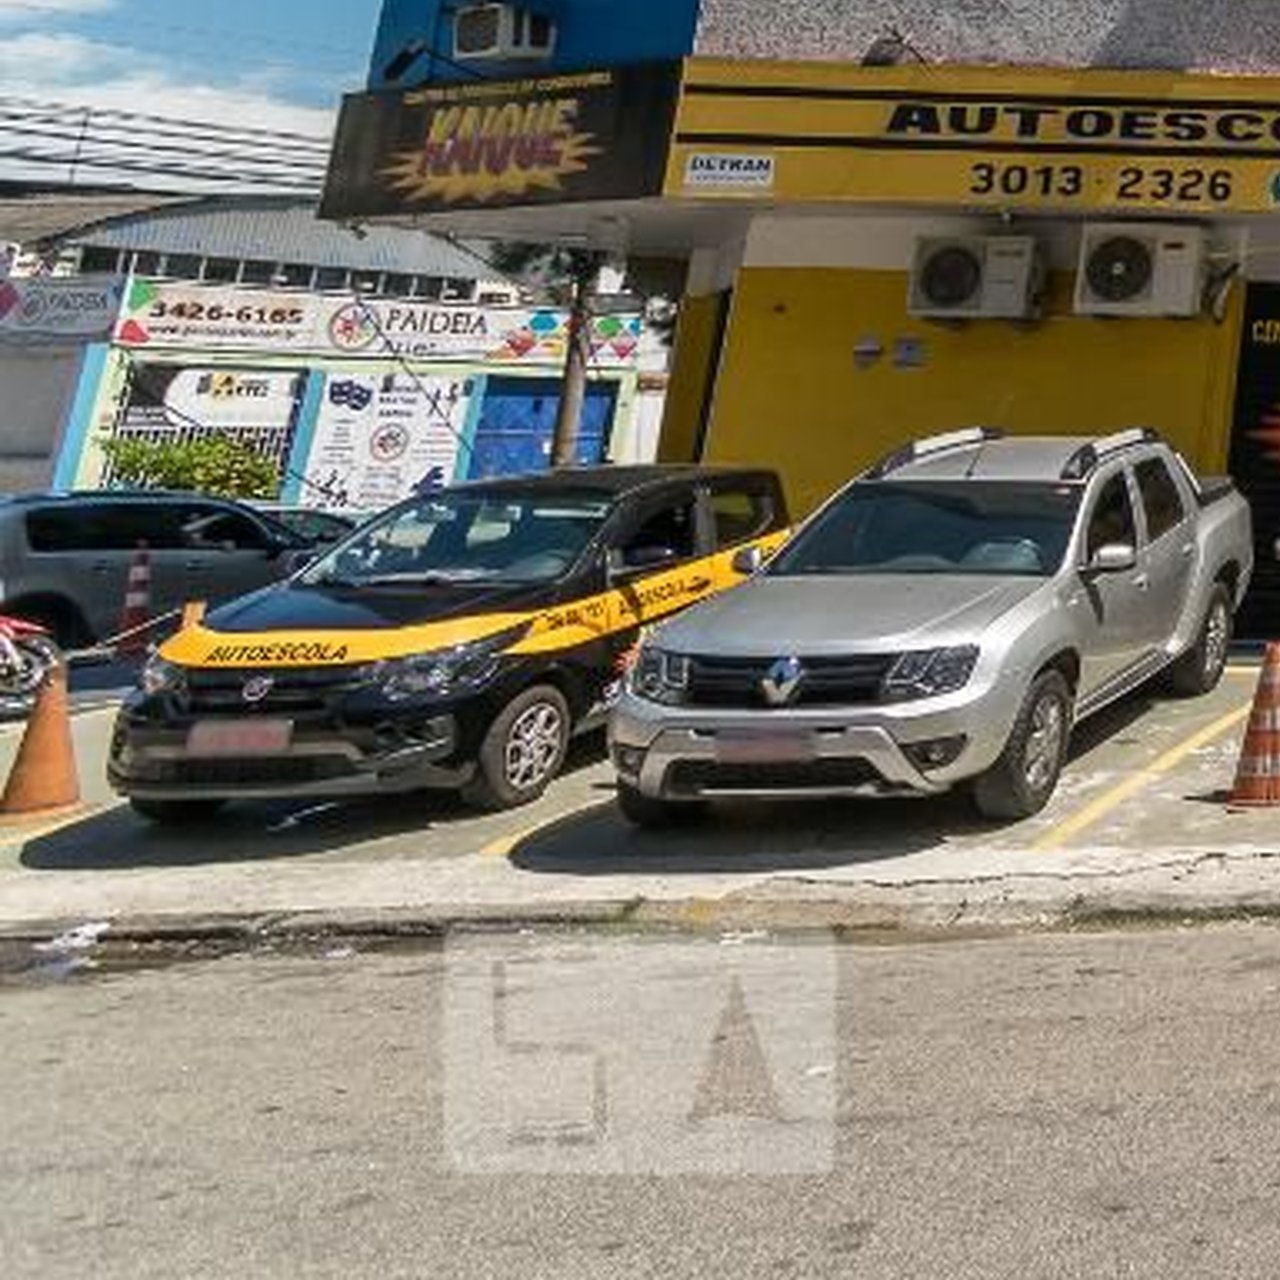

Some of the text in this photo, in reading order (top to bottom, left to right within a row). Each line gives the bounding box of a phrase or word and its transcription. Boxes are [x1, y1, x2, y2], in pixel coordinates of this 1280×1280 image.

[692, 156, 771, 171] DETRAN
[385, 308, 489, 335] PAIDEIA
[203, 642, 349, 663] AUTOESCOLA
